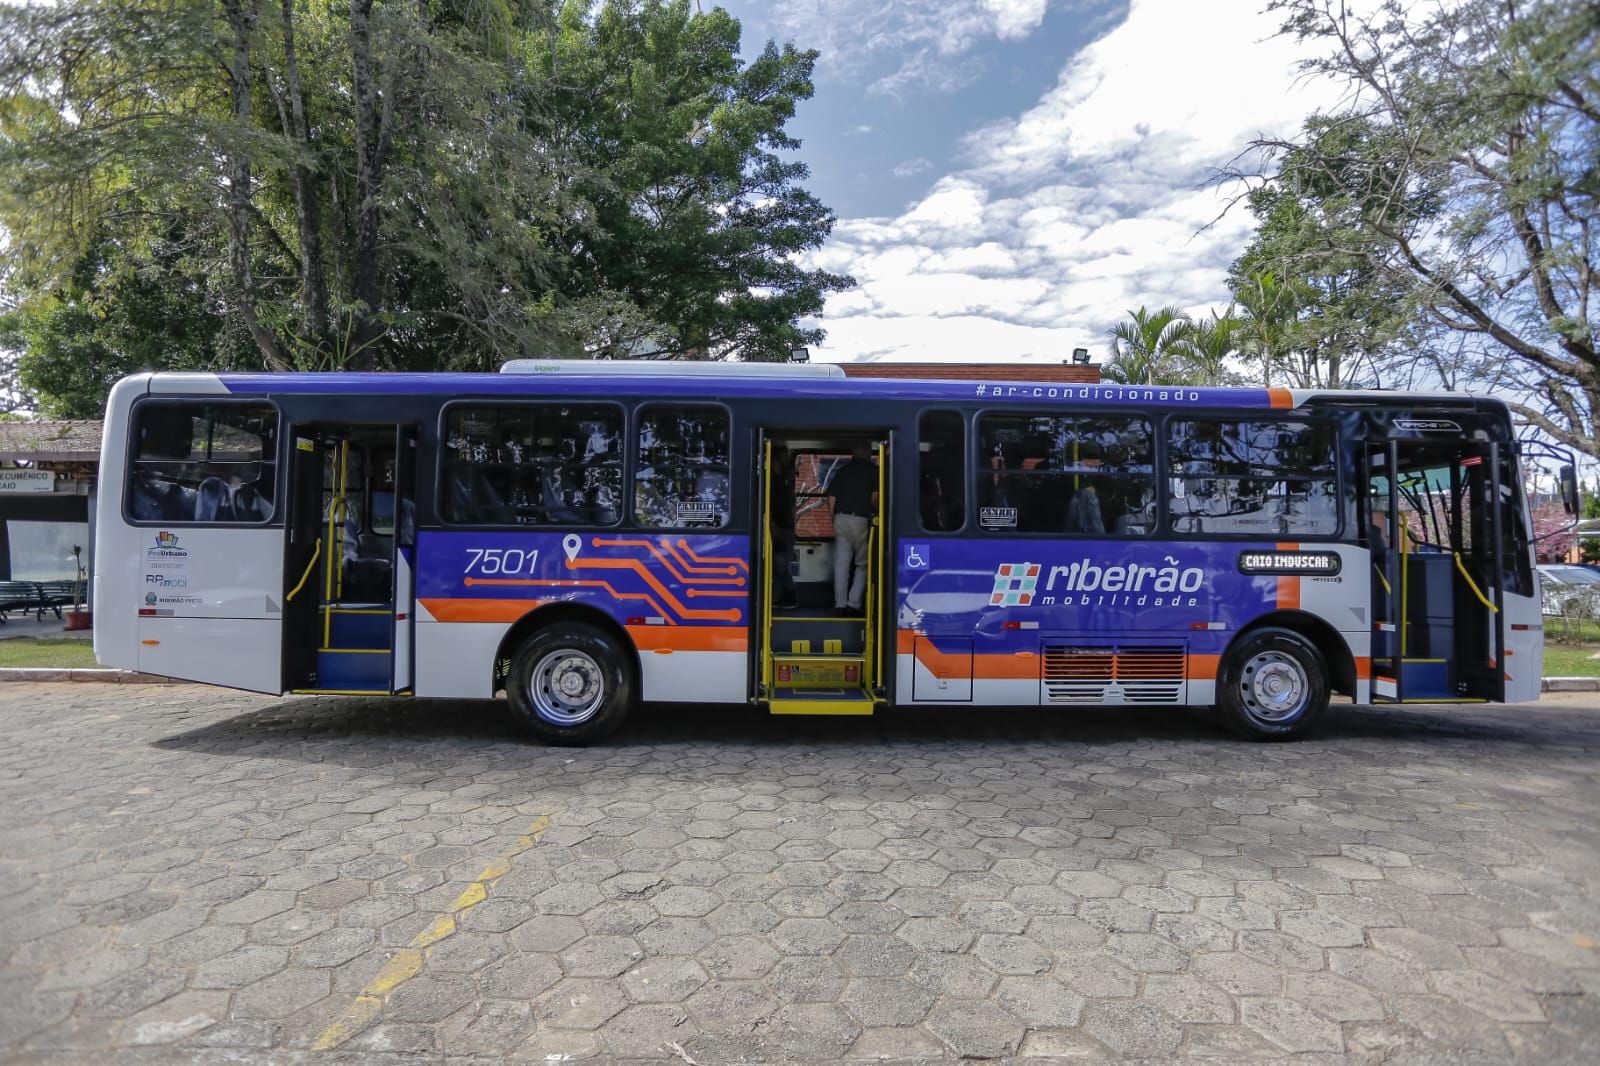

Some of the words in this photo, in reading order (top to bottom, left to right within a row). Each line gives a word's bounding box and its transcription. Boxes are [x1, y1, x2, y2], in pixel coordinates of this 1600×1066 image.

[975, 384, 1199, 401] #ar-condicionado
[464, 549, 538, 574] 7501
[1245, 555, 1272, 567] CAIO
[1046, 555, 1204, 593] ribeirão
[1042, 595, 1197, 606] mobilidade
